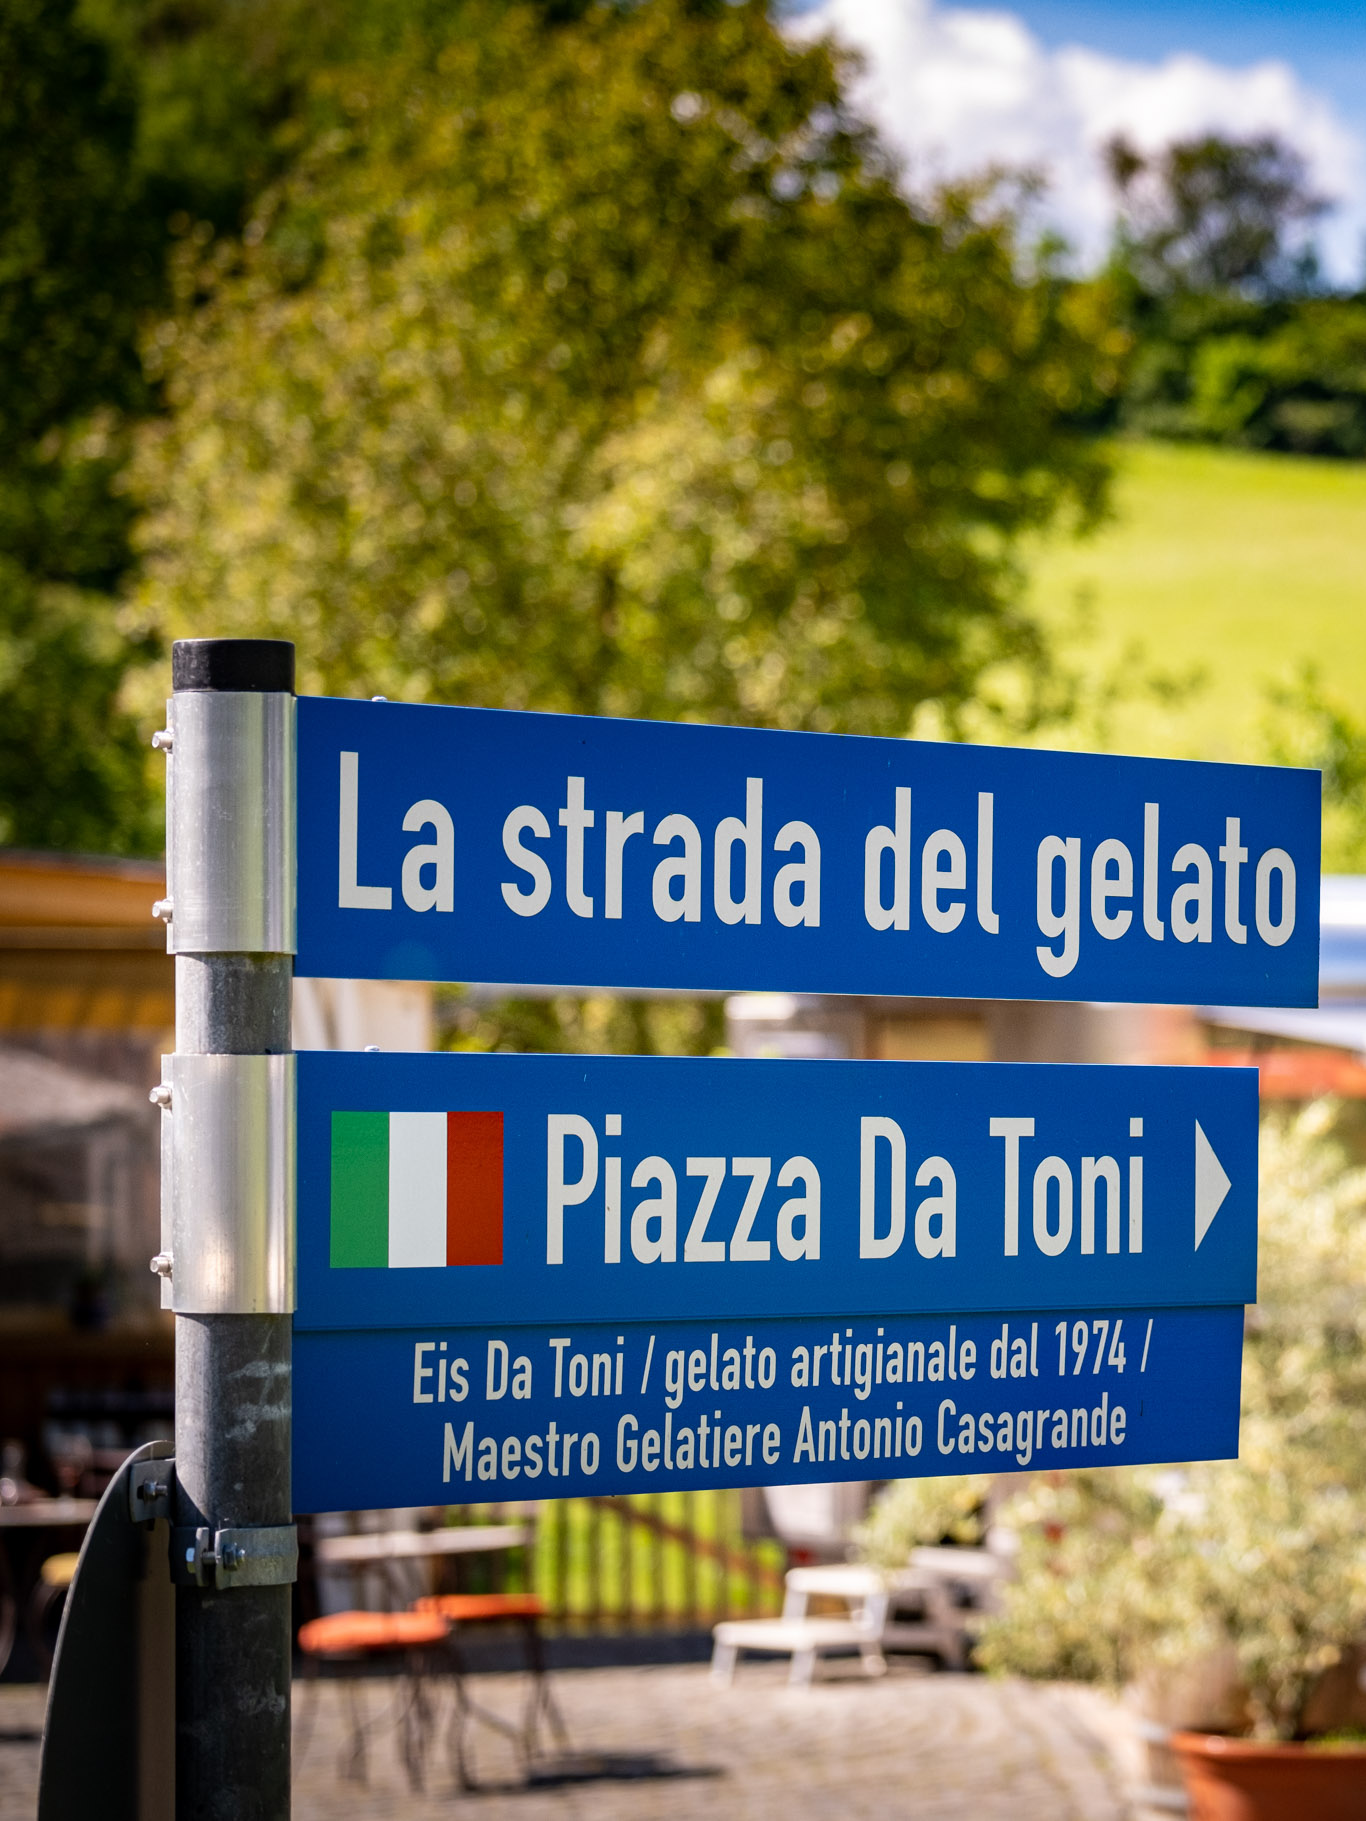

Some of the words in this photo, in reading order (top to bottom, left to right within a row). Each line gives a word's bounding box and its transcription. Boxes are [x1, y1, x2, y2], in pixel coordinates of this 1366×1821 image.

[338, 751, 455, 913] La
[500, 776, 821, 928] strada
[864, 786, 1000, 935] del
[1036, 802, 1297, 978] gelato
[546, 1113, 821, 1265] Piazza
[859, 1116, 957, 1259] Da
[989, 1117, 1144, 1257] Toni
[413, 1342, 469, 1404] Eis
[486, 1340, 532, 1401] Da
[549, 1336, 624, 1398] Toni
[664, 1334, 777, 1410] gelato
[790, 1325, 977, 1401] artigianale
[990, 1322, 1039, 1379] dal
[1055, 1319, 1127, 1376] 1974
[443, 1421, 600, 1483] Maestro
[616, 1412, 781, 1473] Gelatiere
[792, 1398, 923, 1463] Antonio
[937, 1391, 1127, 1466] Casagrande
